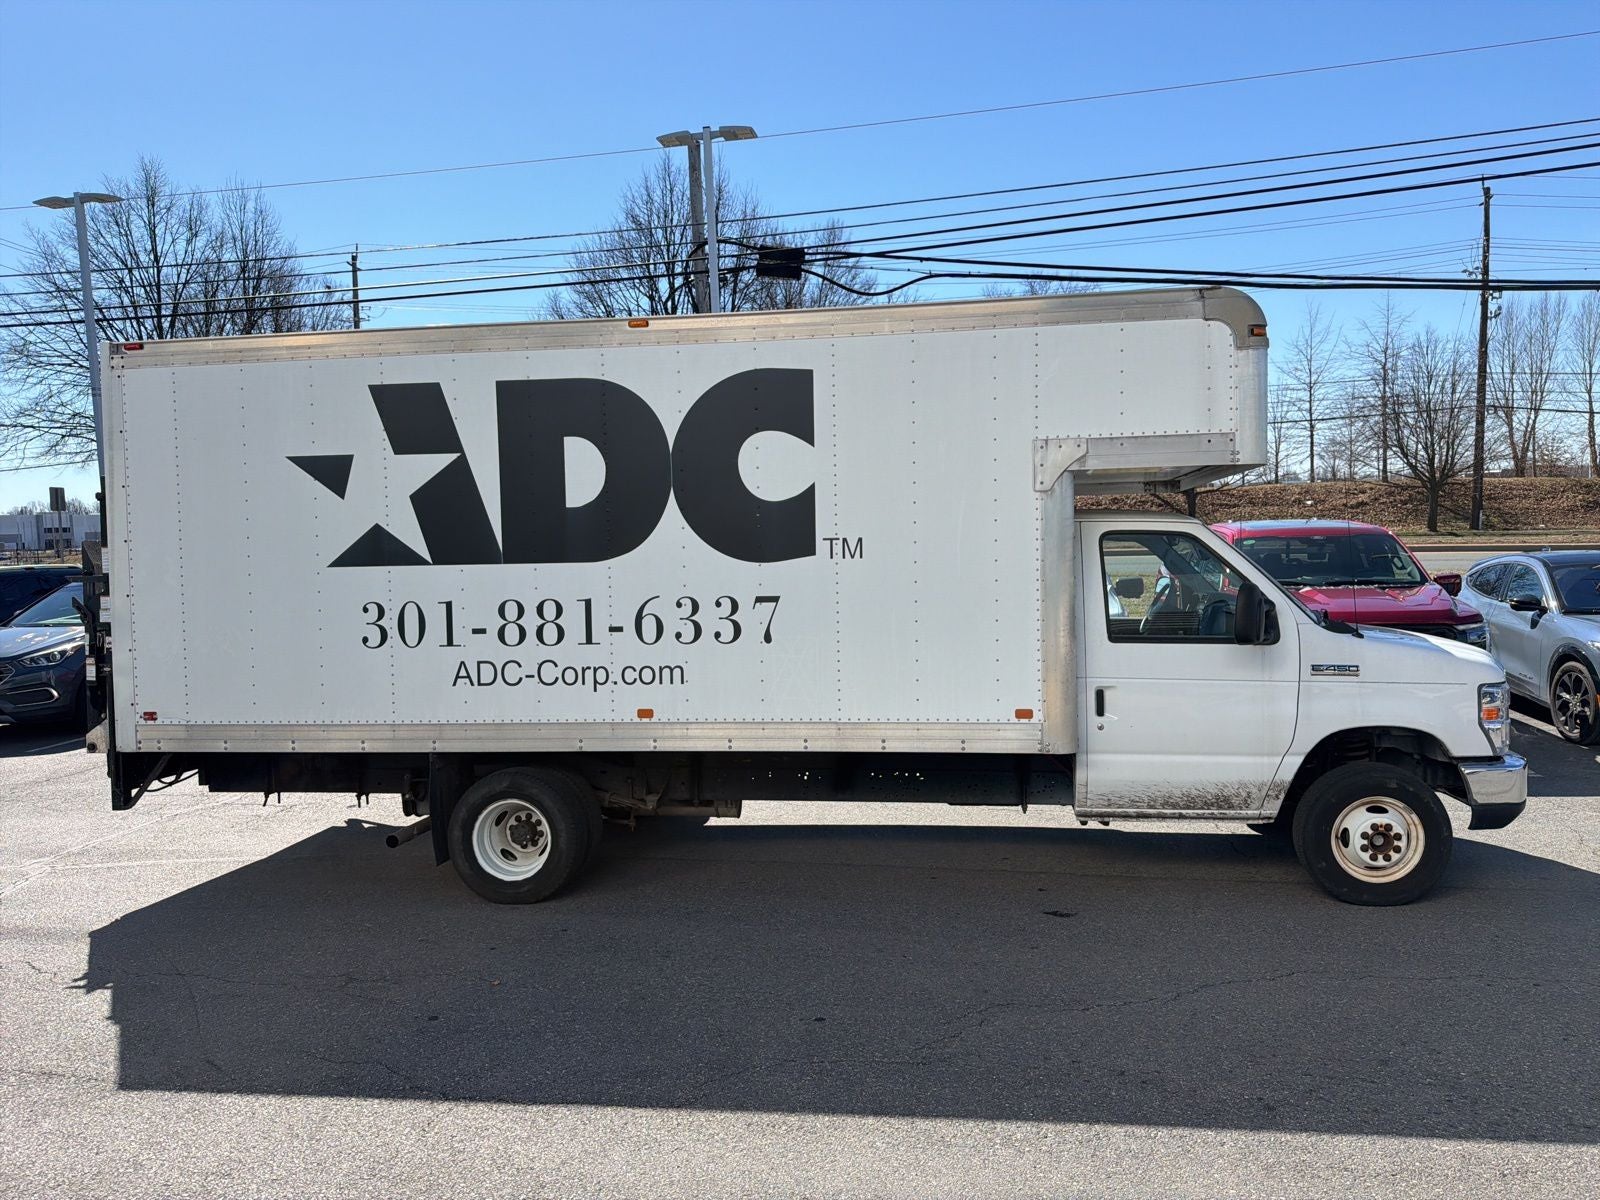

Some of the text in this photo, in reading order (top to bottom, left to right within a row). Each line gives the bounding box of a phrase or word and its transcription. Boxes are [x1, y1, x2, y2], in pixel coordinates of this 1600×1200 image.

[286, 368, 817, 566] ADC
[822, 537, 863, 560] TM
[361, 595, 781, 649] 301-881-6337
[452, 659, 685, 692] ADC-Corp.com
